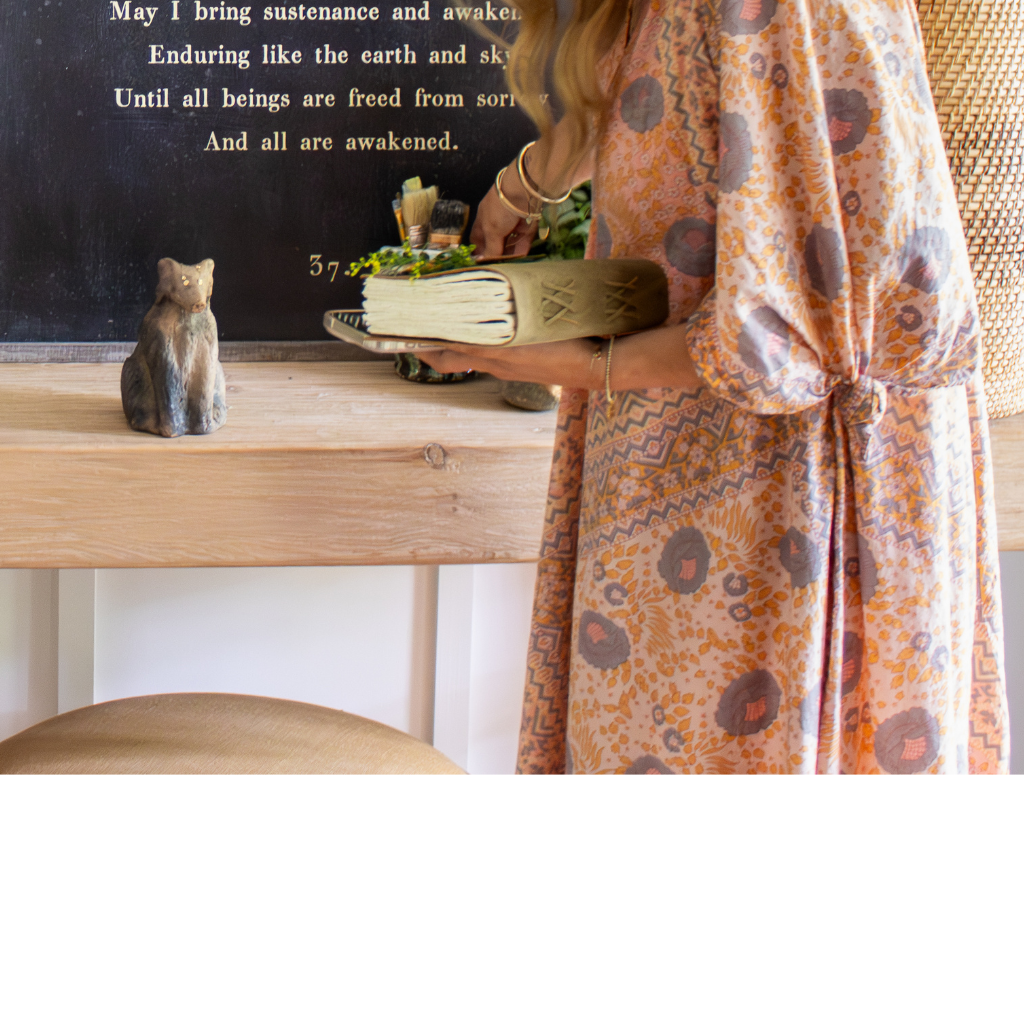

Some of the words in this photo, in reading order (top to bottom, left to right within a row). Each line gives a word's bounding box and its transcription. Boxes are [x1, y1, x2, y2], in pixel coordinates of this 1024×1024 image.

[109, 0, 159, 28] May
[170, 0, 180, 21] I
[193, 0, 252, 26] bring
[263, 3, 380, 21] sustenance
[392, 0, 431, 21] and
[147, 43, 251, 70] Enduring
[261, 43, 303, 65] like
[314, 43, 349, 65] the
[361, 43, 417, 64] earth
[428, 44, 467, 64] and
[113, 87, 170, 108] Until
[182, 87, 209, 108] all
[221, 87, 291, 113] beings
[302, 93, 336, 108] are
[348, 87, 402, 107] freed
[415, 87, 464, 107] from
[203, 130, 248, 151] And
[261, 131, 287, 151] all
[300, 137, 333, 151] are
[345, 130, 459, 151] awakened.
